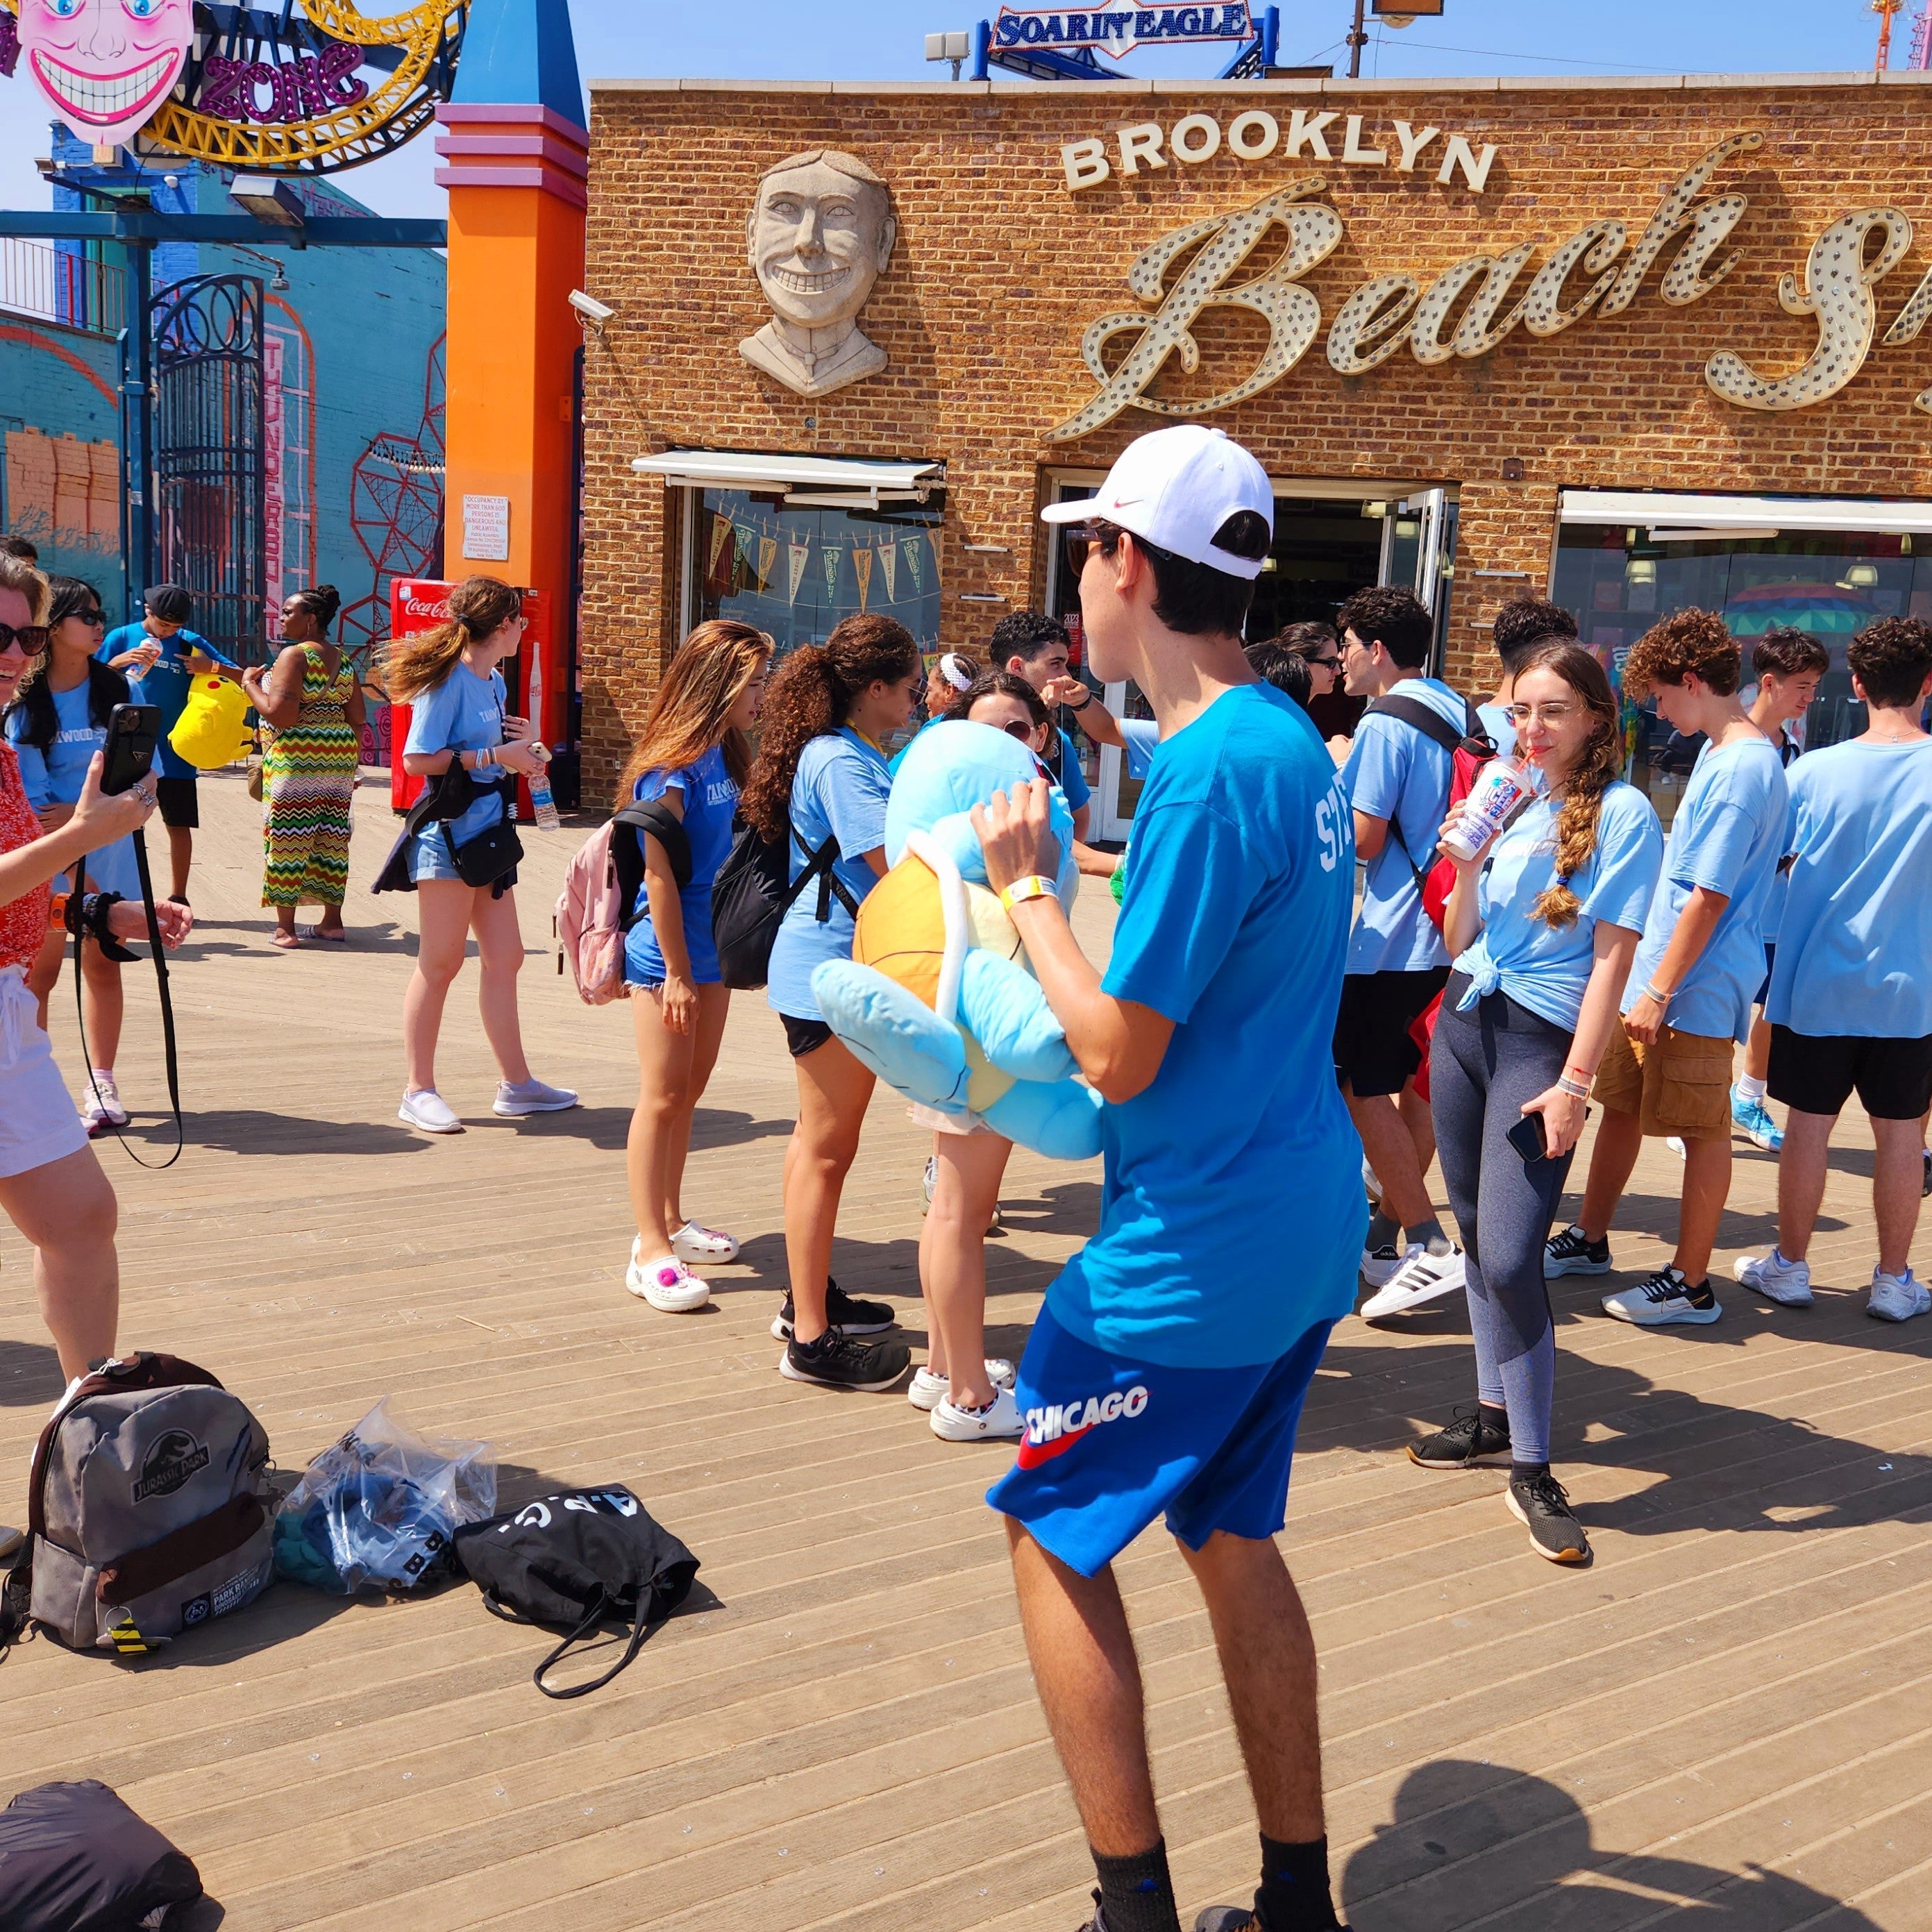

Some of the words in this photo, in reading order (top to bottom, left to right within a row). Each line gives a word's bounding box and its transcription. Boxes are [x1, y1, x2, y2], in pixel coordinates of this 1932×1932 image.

[1134, 3, 1247, 37] EAGLE
[1059, 110, 1497, 194] BROOKLYN
[1042, 130, 1765, 444] Beach
[825, 551, 834, 584] Nathan's
[405, 598, 451, 618] Coca-Co
[1064, 614, 1079, 623] 2023
[1500, 779, 1516, 794] 25
[1026, 1386, 1148, 1443] CHICAGO
[137, 1465, 179, 1500] JURASSIC
[180, 1451, 208, 1477] PARK
[214, 1588, 235, 1606] PARK
